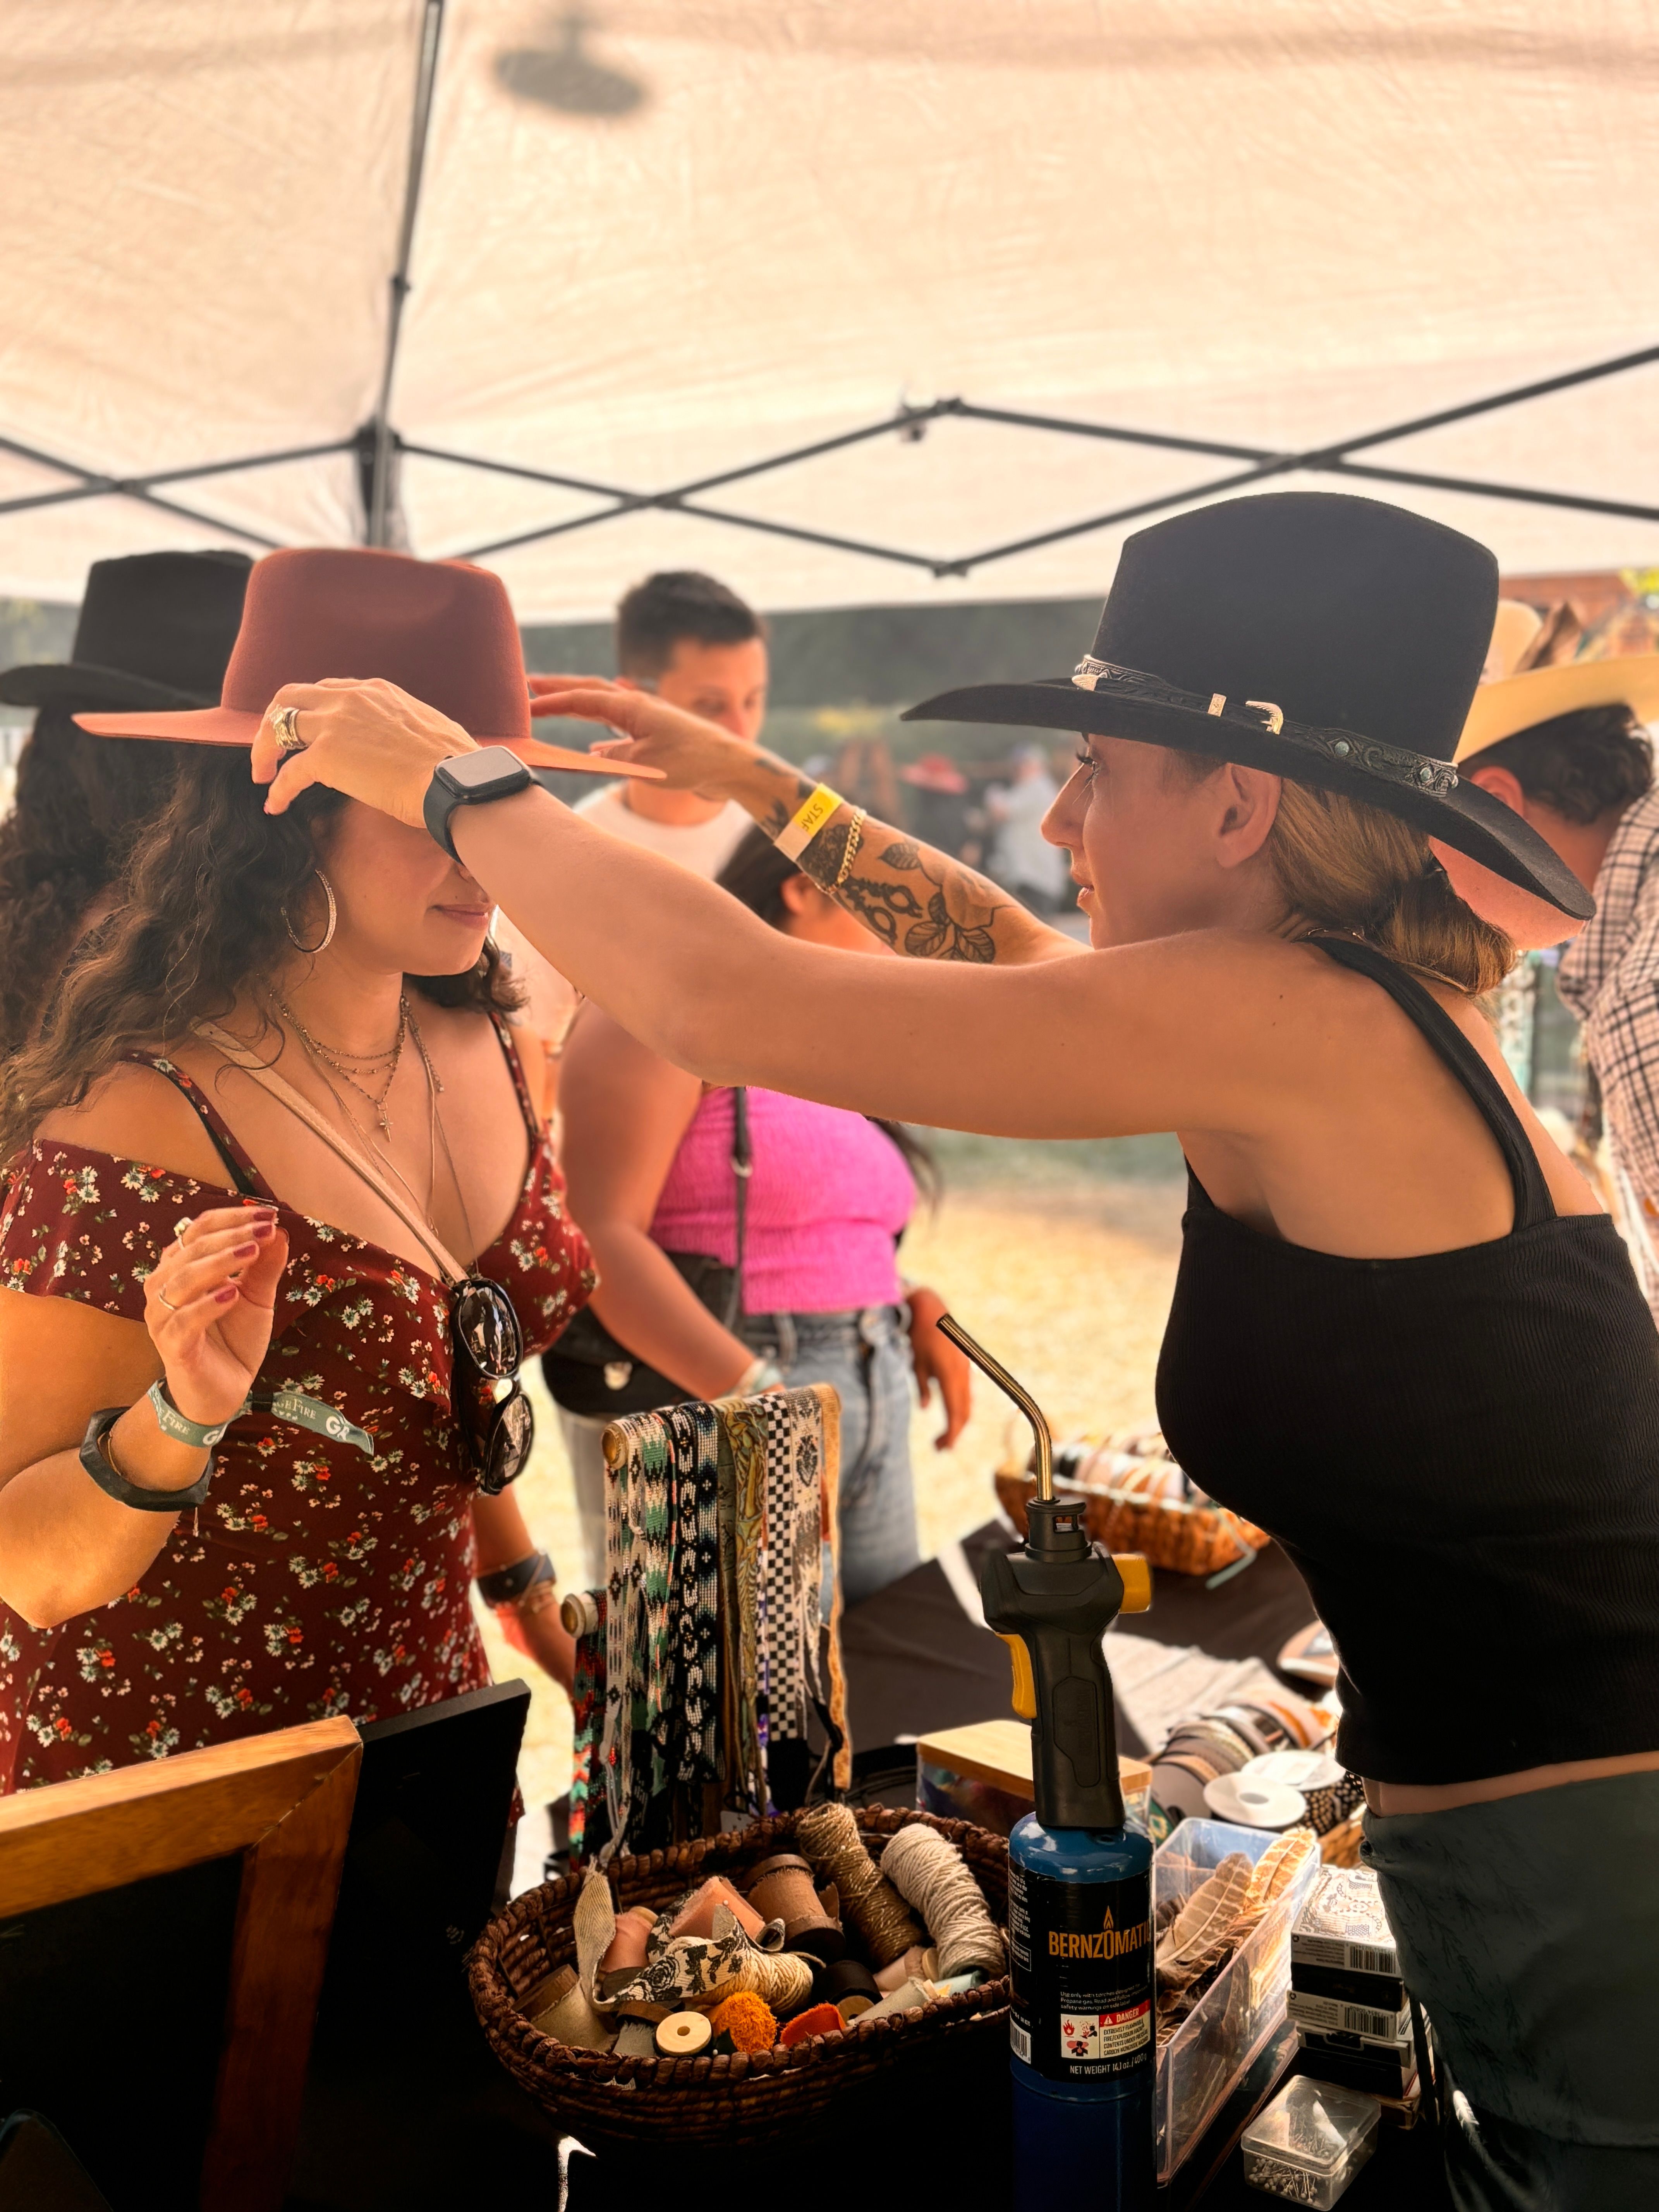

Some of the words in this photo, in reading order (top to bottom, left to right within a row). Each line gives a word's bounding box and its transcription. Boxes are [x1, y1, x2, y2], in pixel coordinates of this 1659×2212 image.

[1116, 2008, 1139, 2023] DANGER
[1104, 2026, 1125, 2035] EXTREMELY
[1104, 2040, 1123, 2049] CONTENTS
[1124, 2036, 1135, 2045] UNDER
[1104, 2048, 1120, 2056] CARBON
[1120, 2041, 1138, 2052] MONOXIDE
[1070, 2065, 1082, 2075] NET
[1084, 2064, 1111, 2075] WEIGHT
[1113, 2062, 1121, 2071] 14.1
